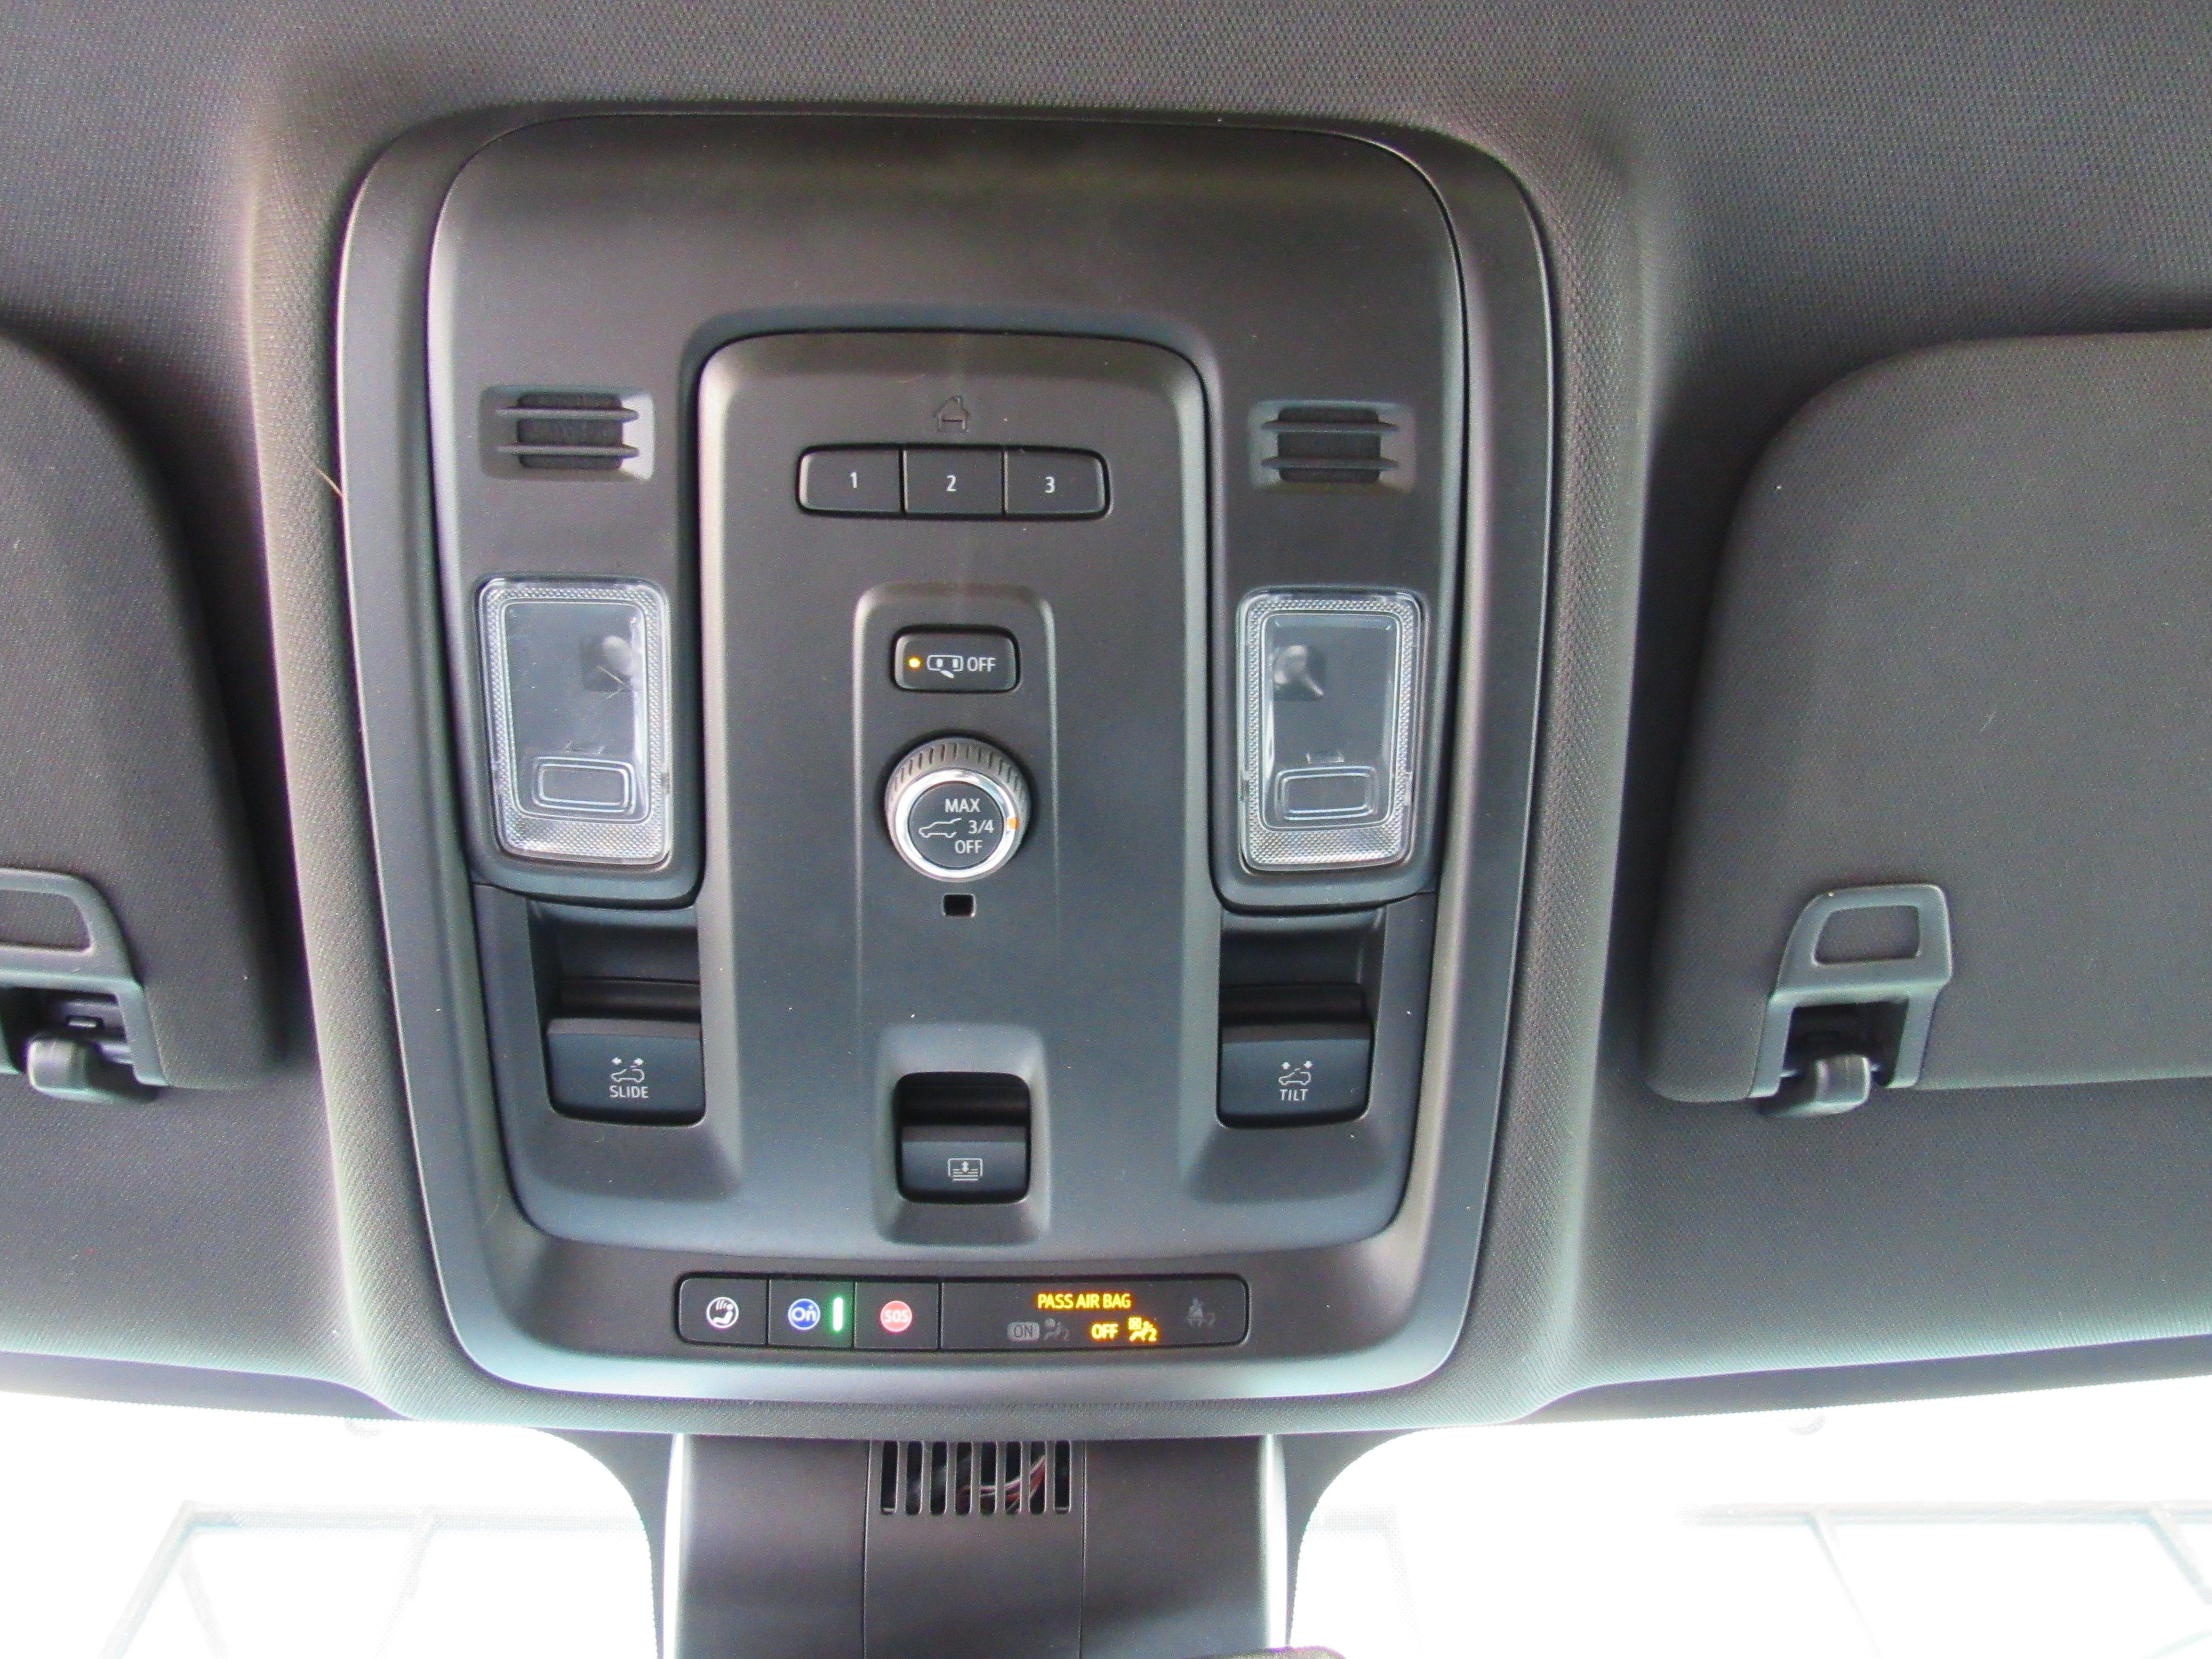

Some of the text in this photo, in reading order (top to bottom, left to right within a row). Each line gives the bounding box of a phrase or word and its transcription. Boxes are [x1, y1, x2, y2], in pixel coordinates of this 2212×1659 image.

[850, 471, 858, 489] 1
[946, 475, 957, 492] 2
[1045, 476, 1056, 493] 3
[967, 657, 996, 672] OFF
[945, 798, 981, 813] MAX
[968, 819, 995, 834] 3/4
[954, 840, 984, 854] OFF
[609, 1085, 649, 1098] SLIDE
[1279, 1089, 1309, 1101] TILT
[1037, 1293, 1131, 1309] PASS AIR BAG
[883, 1309, 910, 1322] SOS
[1013, 1323, 1034, 1339] ON
[1091, 1323, 1118, 1339] OFF
